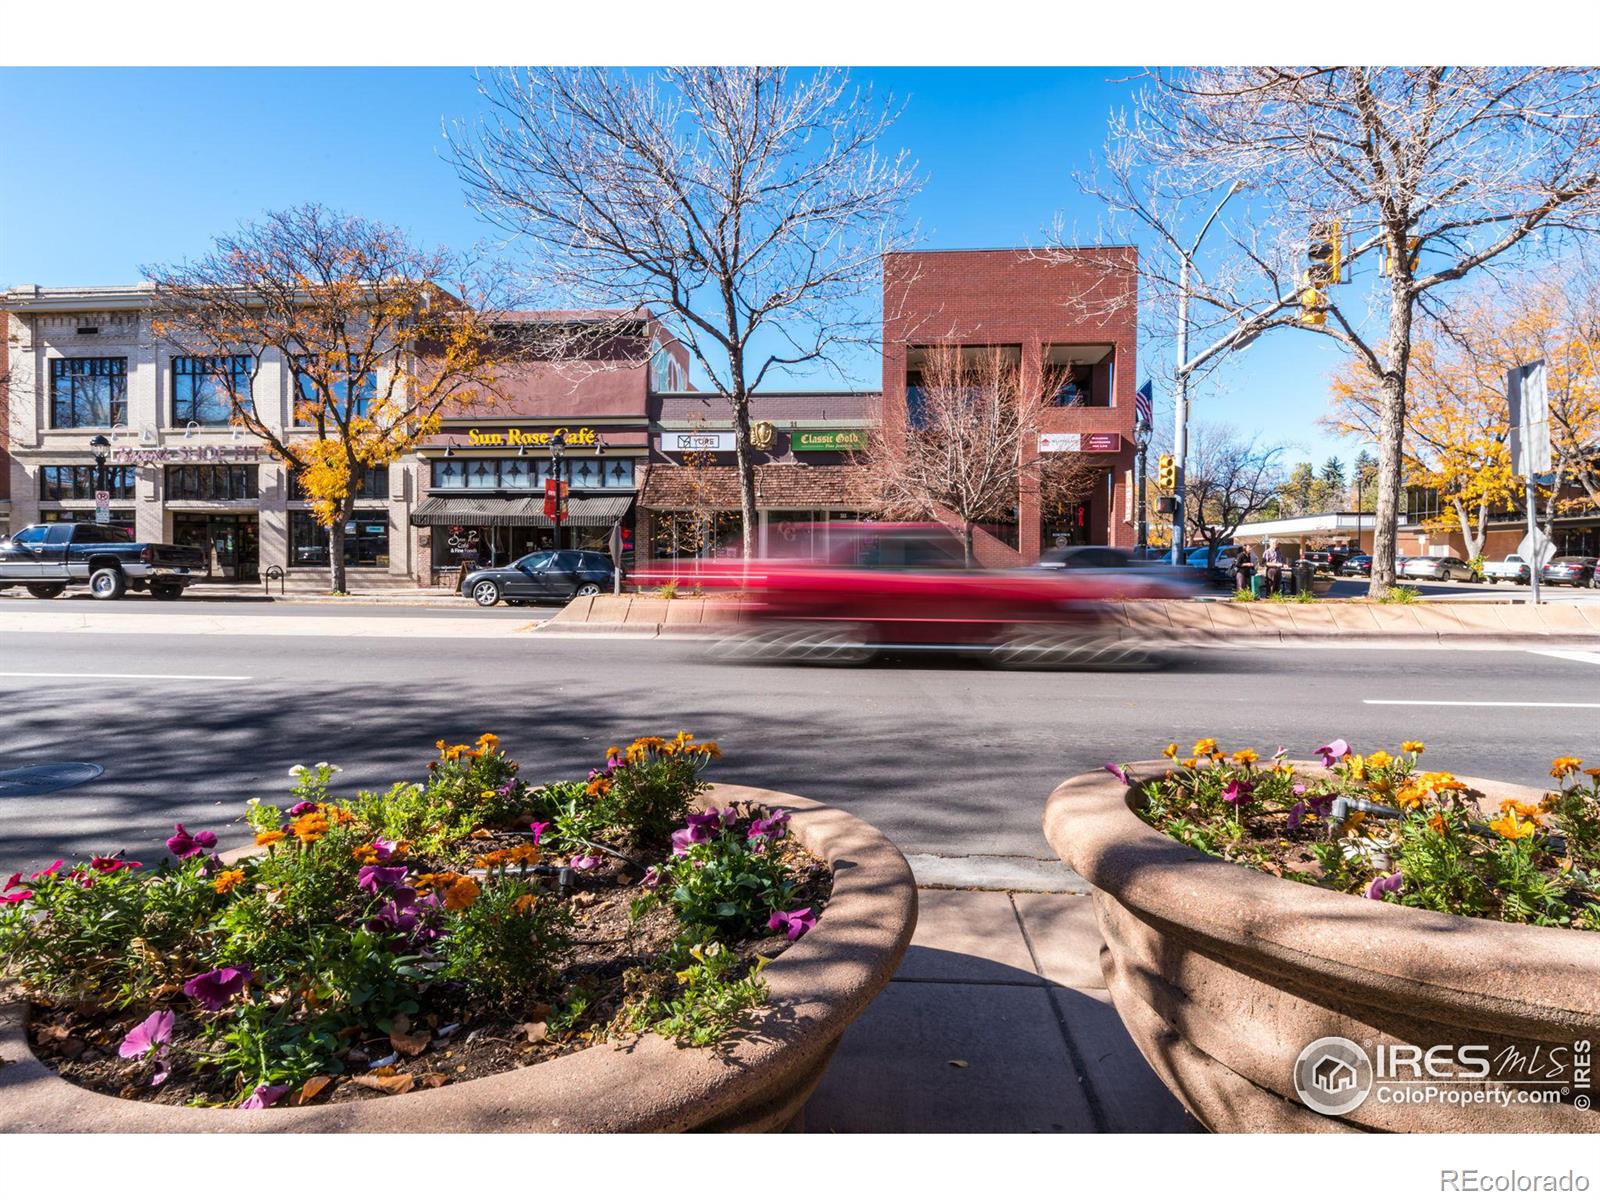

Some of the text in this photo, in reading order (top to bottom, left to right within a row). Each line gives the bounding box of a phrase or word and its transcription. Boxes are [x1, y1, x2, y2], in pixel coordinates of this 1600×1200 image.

[468, 428, 502, 445] Sun
[508, 428, 549, 445] Rose
[800, 433, 859, 444] Classic Gold
